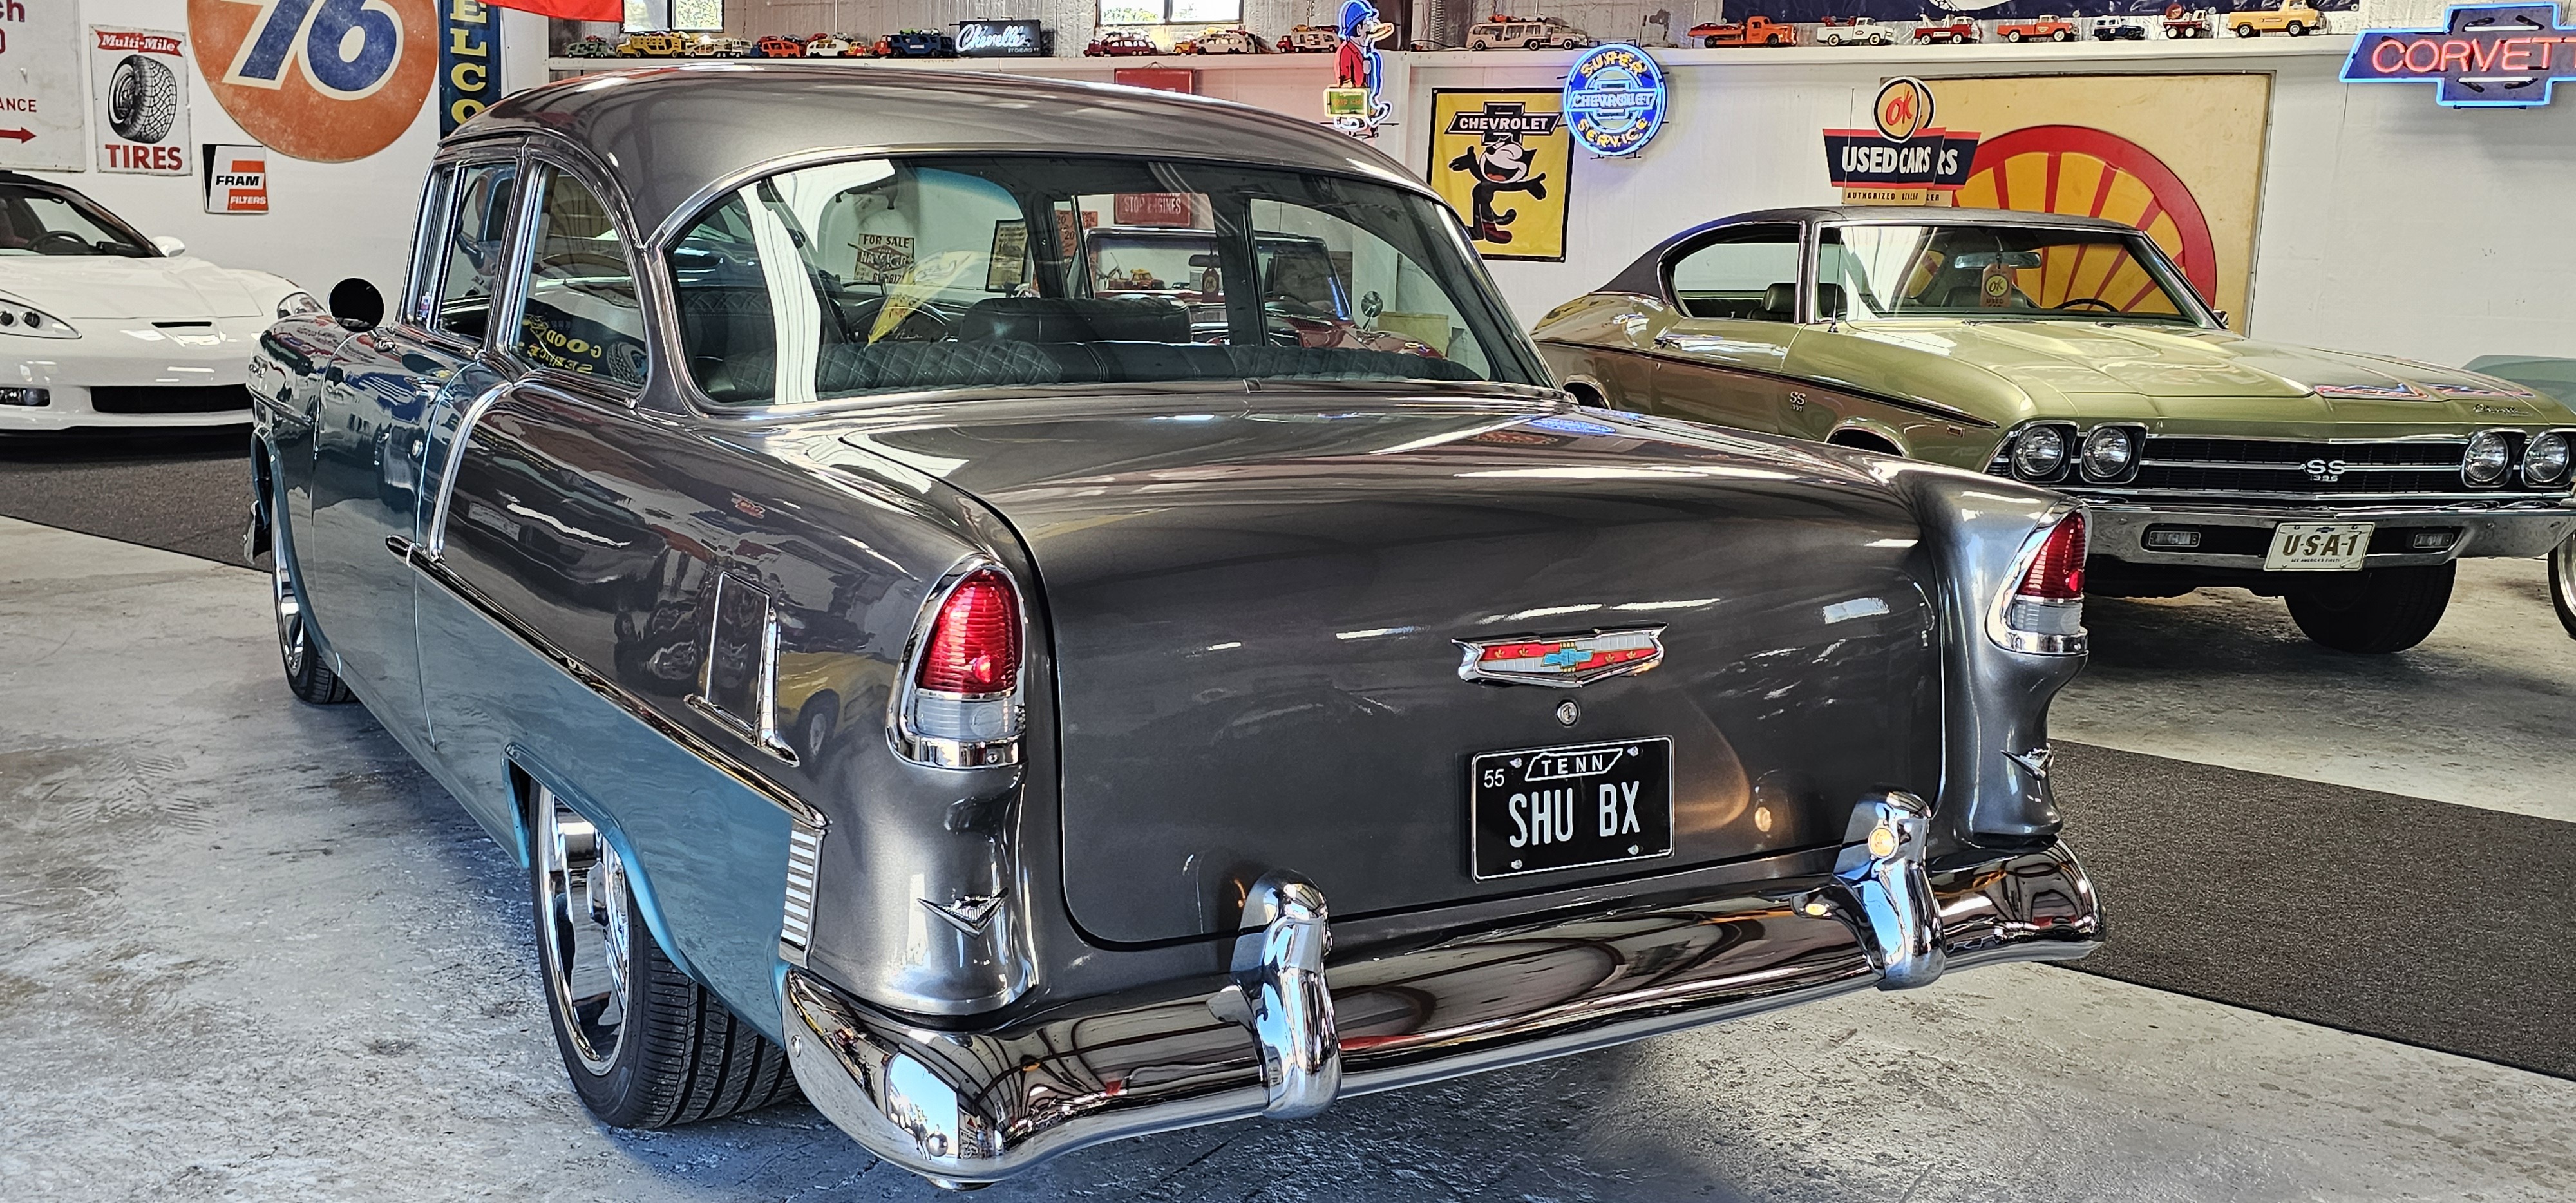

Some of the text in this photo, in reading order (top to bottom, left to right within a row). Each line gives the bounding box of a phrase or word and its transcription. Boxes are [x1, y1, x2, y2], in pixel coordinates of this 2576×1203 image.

[101, 34, 176, 52] Multi-Mile
[956, 24, 1031, 52] Chevelle
[222, 0, 404, 100] 76
[1580, 52, 1649, 77] SUPER
[1573, 93, 1653, 108] CHEVROLET
[1885, 90, 1913, 126] OK
[1459, 117, 1548, 130] CHEVROLET
[1577, 118, 1651, 148] SERVICE
[105, 144, 183, 171] TIRES
[1842, 146, 1931, 174] USED CARS
[216, 175, 260, 186] FRAM
[230, 196, 267, 205] FILTERS
[1847, 191, 1918, 200] AUTHORIZED DEALER
[863, 234, 909, 249] FOR SALE
[1989, 278, 2004, 292] OK
[1790, 391, 1806, 404] SS
[2307, 459, 2345, 475] SS
[1541, 754, 1604, 777] TENN
[1483, 768, 1504, 788] 55
[1508, 781, 1640, 848] SHU BX
